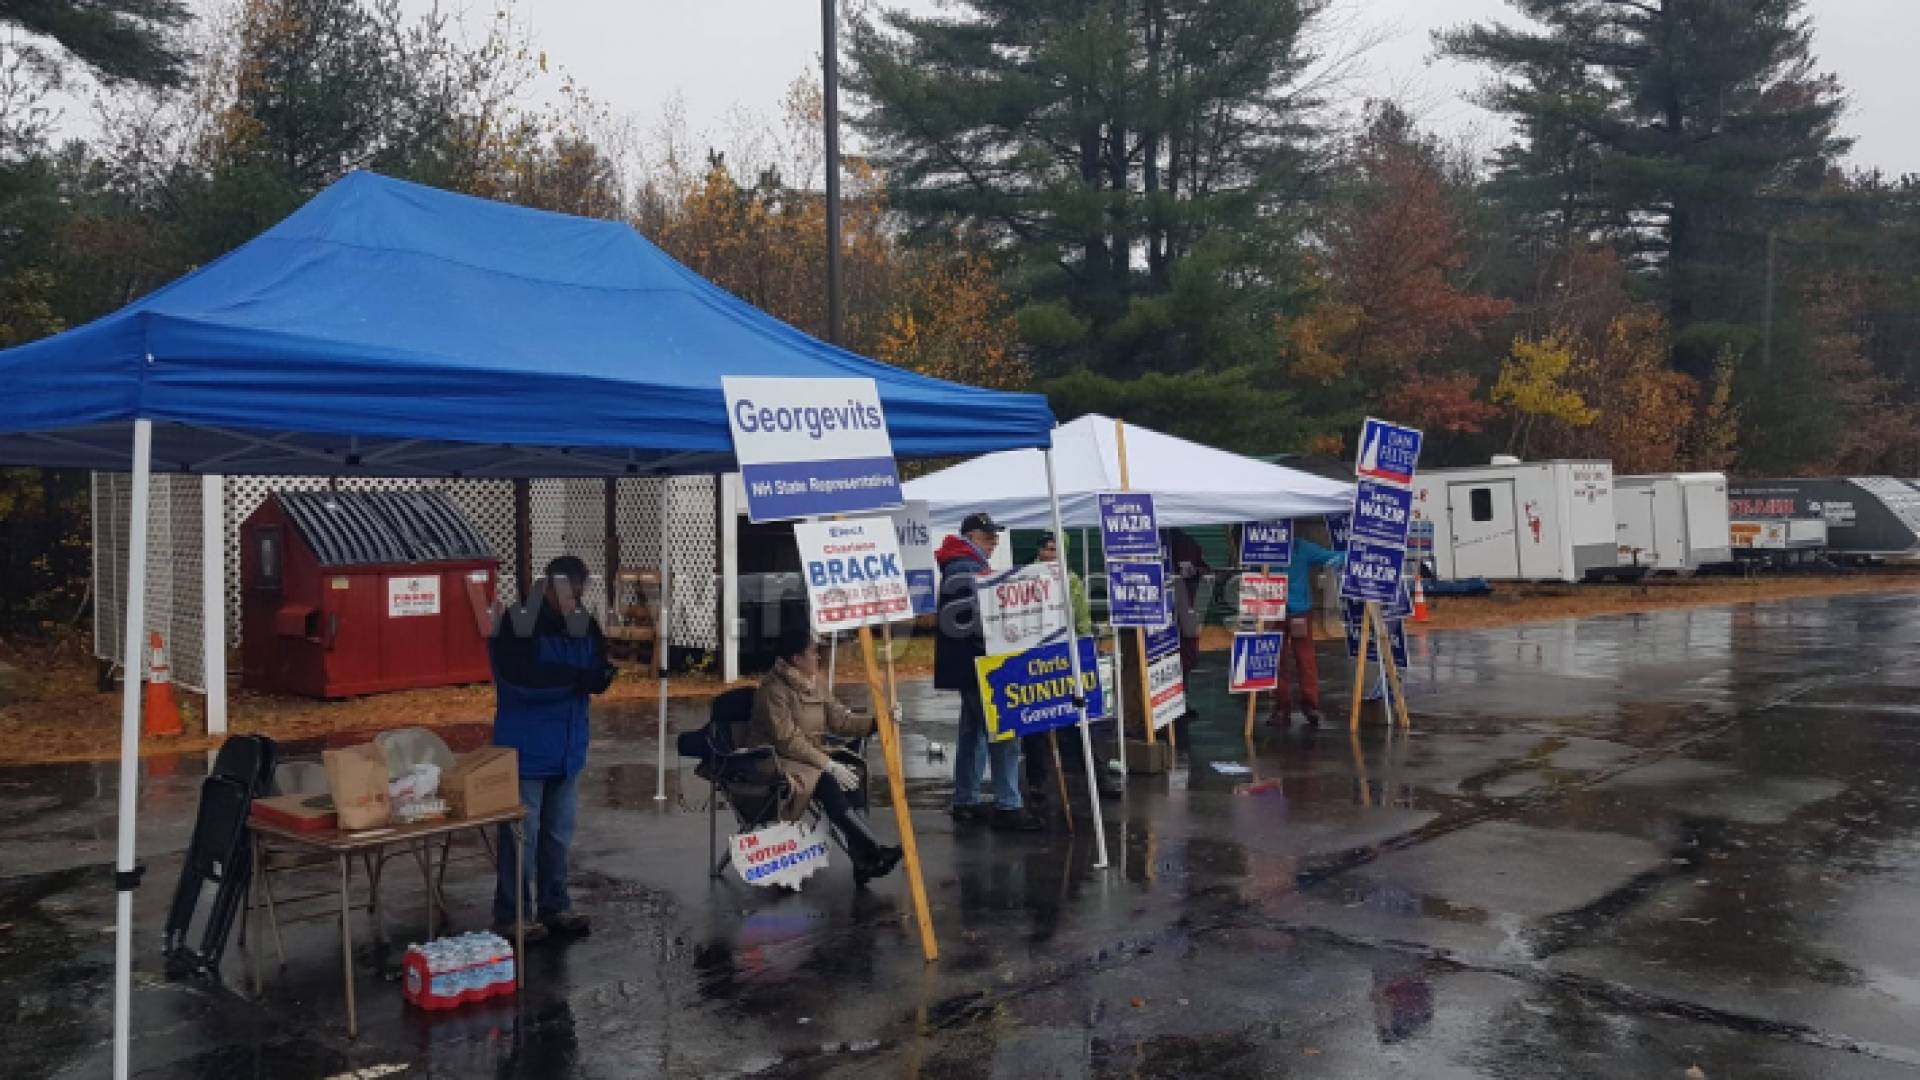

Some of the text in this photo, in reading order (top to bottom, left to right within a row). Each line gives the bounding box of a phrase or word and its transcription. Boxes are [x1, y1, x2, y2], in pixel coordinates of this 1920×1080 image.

[734, 398, 882, 440] Georgevits
[752, 473, 895, 498] NH State Representative
[1360, 500, 1406, 523] WAZIR
[1105, 514, 1152, 533] WAZIR
[1247, 527, 1289, 544] WAZIR
[807, 552, 901, 587] BRACK
[1352, 562, 1397, 582] WAZIR
[995, 577, 1051, 608] SOUCY
[1113, 584, 1160, 603] WAZIR
[1255, 639, 1276, 654] DAN
[1027, 655, 1071, 677] Chris
[746, 839, 798, 865] VOTING
